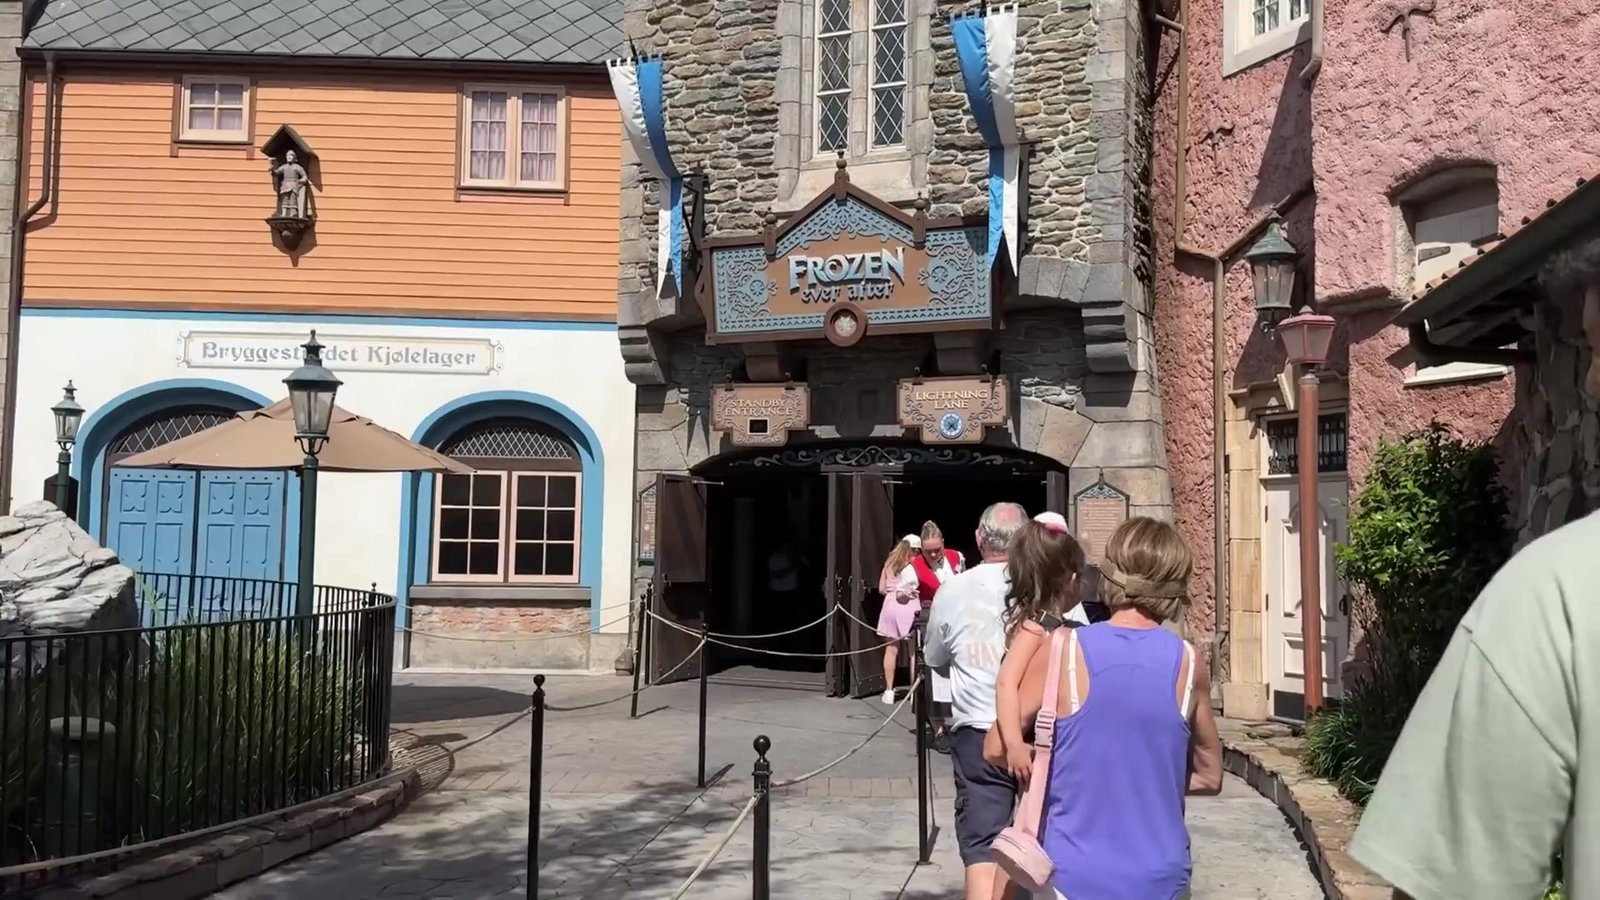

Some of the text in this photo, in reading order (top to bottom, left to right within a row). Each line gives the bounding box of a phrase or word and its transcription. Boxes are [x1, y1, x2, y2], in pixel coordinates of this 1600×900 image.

[788, 246, 905, 295] FROZEN
[801, 281, 895, 303] ever after
[202, 341, 476, 367] Bryggestdet Kjølelager
[916, 389, 988, 401] LIGHTNING
[730, 399, 786, 408] STANDBY
[934, 400, 969, 410] LANE
[725, 407, 793, 417] ENTRANCE
